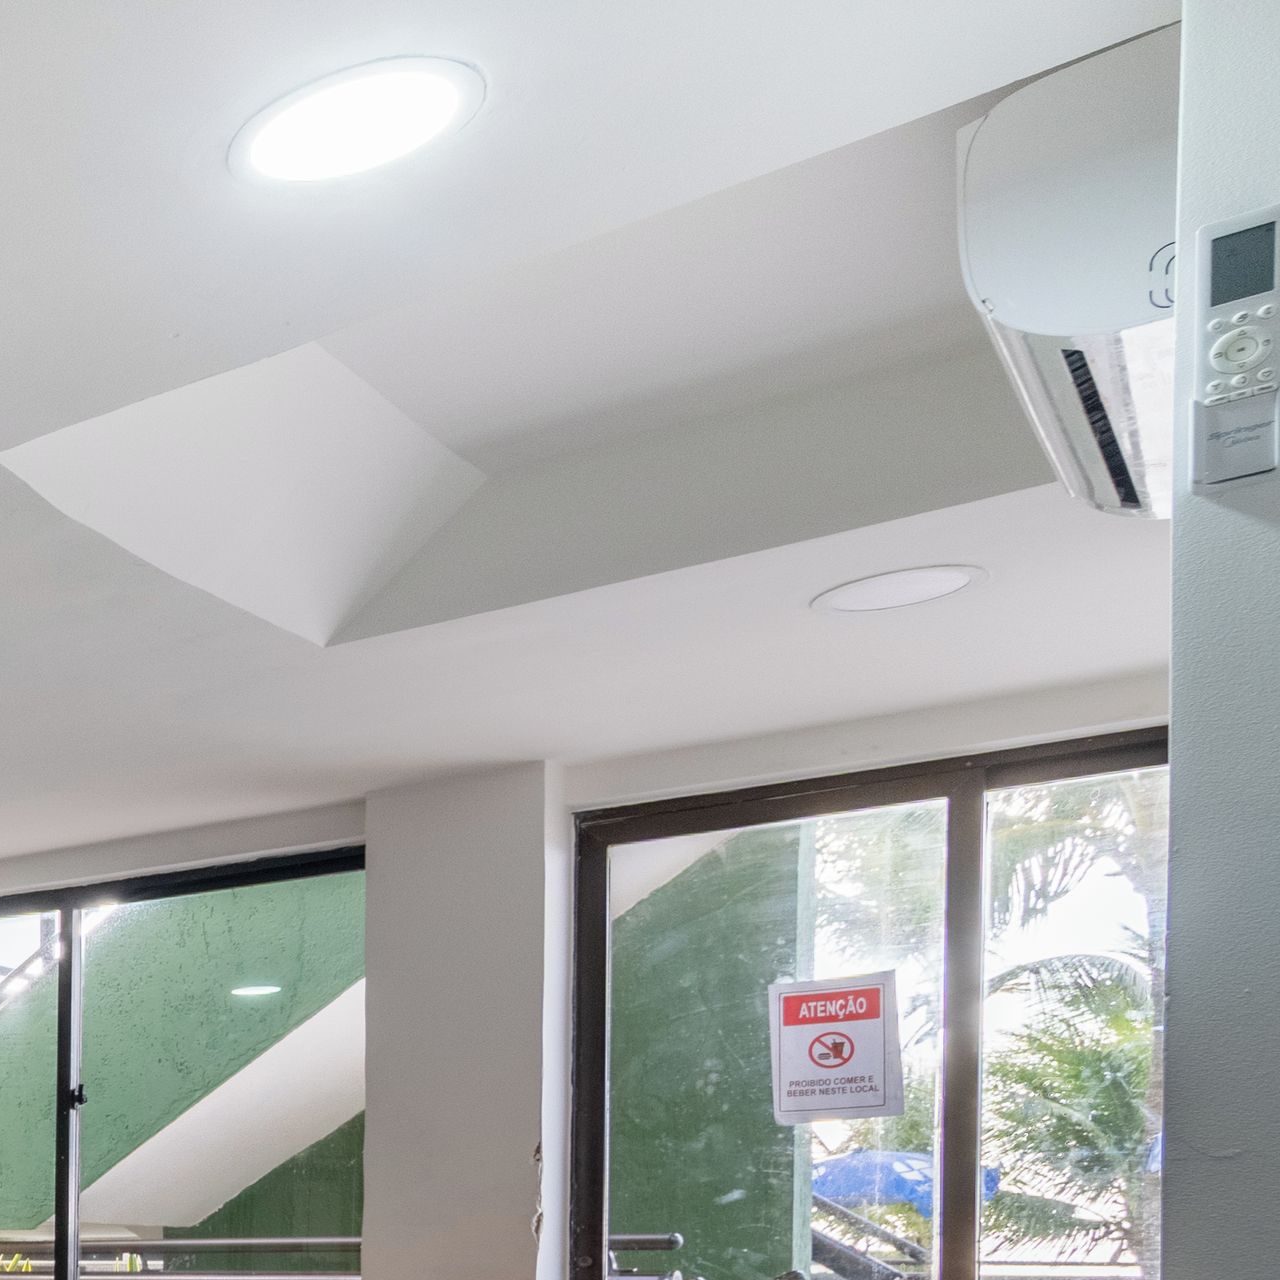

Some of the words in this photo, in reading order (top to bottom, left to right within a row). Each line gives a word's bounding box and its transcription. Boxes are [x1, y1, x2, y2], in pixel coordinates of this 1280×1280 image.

[799, 995, 867, 1019] ATENÇÃO
[789, 1078, 831, 1088] PROIBIDO
[833, 1076, 866, 1086] COMER
[868, 1074, 874, 1083] E
[787, 1089, 817, 1098] BEBER
[819, 1087, 847, 1096] NESTE
[849, 1085, 880, 1094] LOCAL
